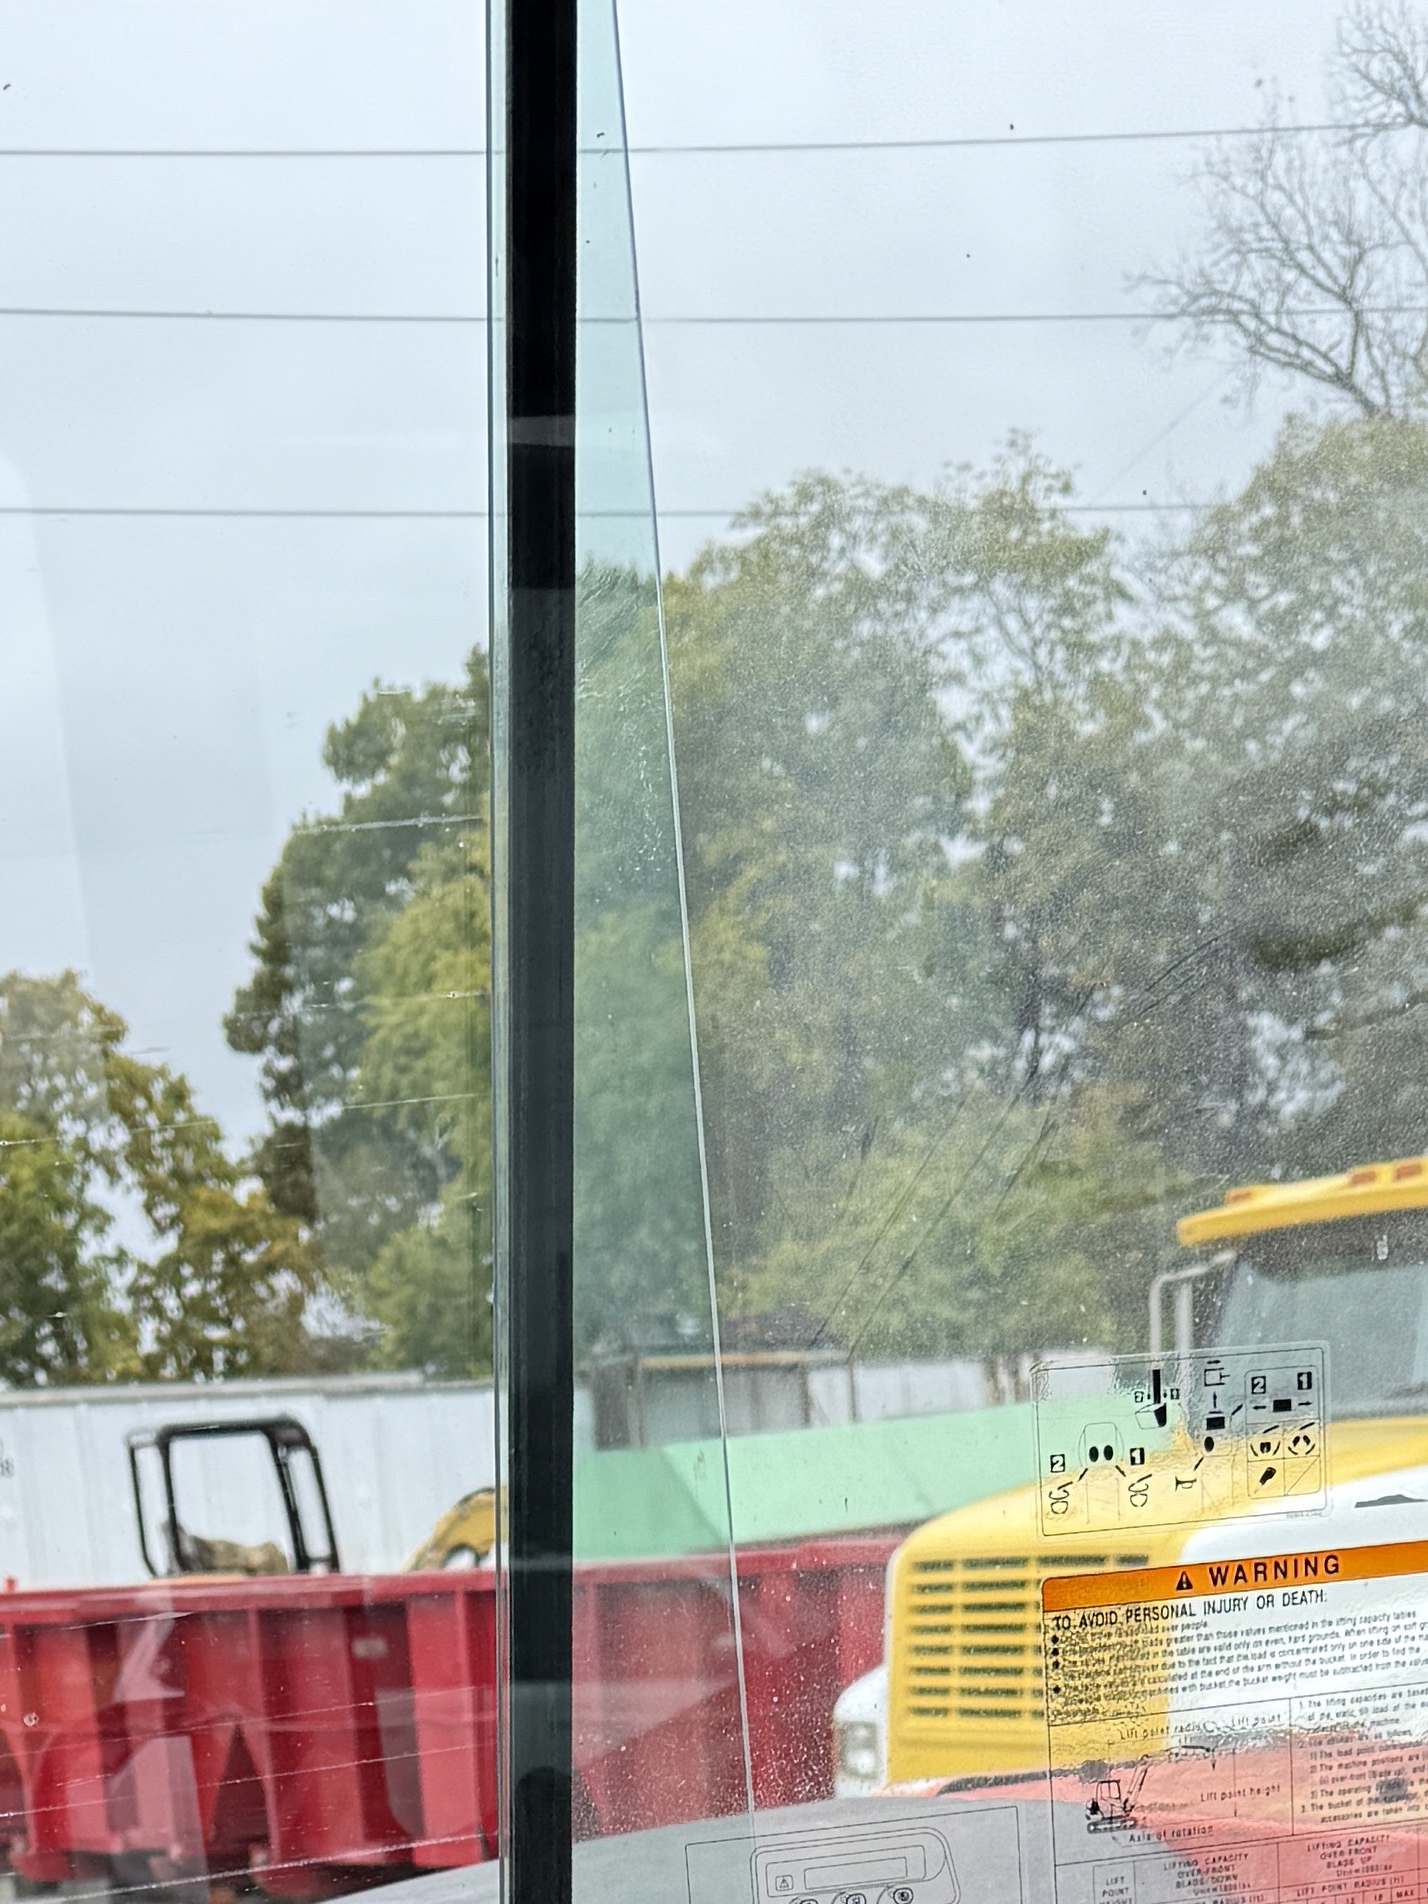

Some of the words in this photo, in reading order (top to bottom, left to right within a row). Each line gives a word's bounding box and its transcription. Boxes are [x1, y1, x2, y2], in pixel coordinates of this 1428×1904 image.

[1252, 1377, 1265, 1393] 2
[1052, 1456, 1063, 1471] 2
[1209, 1554, 1339, 1587] WARNING
[1053, 1616, 1071, 1630] TO
[1079, 1611, 1118, 1627] AVOID
[1125, 1603, 1196, 1623] PERSONAL
[1203, 1598, 1248, 1615] INJURY
[1256, 1595, 1274, 1609] OR
